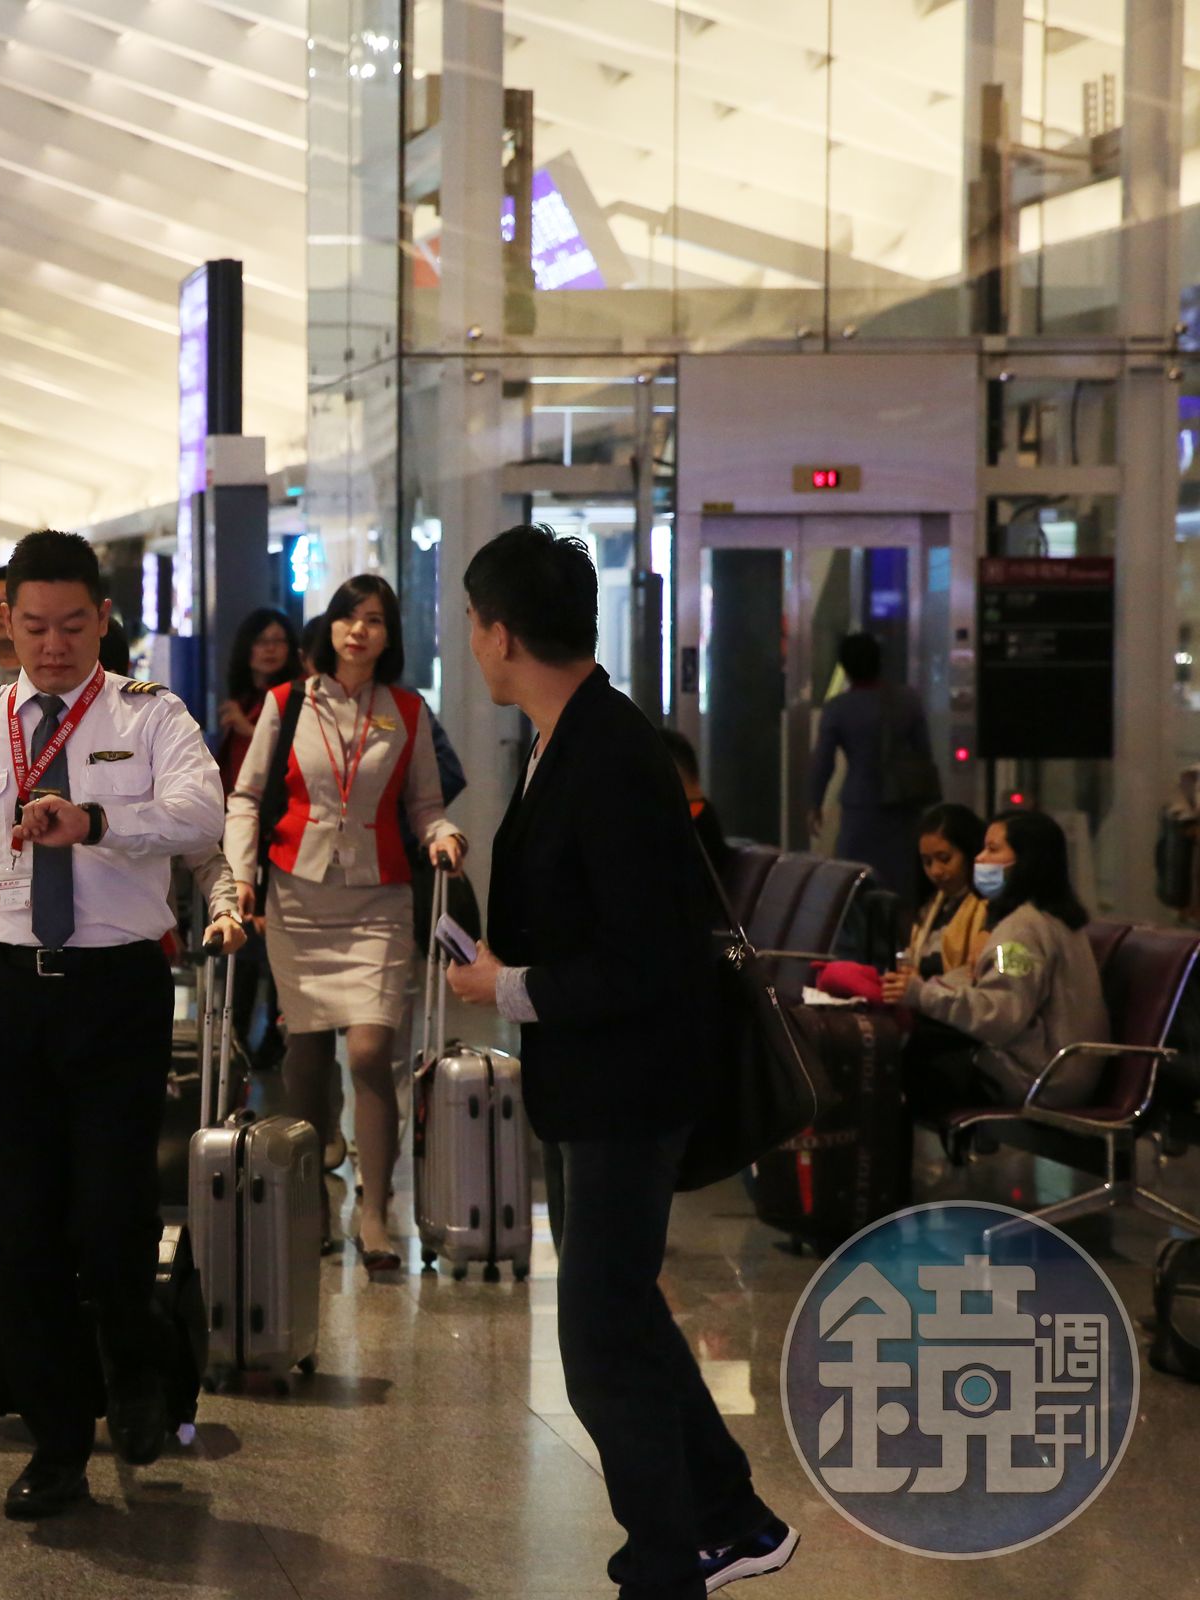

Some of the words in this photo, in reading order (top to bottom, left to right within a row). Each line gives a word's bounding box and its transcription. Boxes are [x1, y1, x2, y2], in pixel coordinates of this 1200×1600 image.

[10, 717, 20, 740] FLIGHT
[53, 721, 73, 748] REMOVE
[12, 740, 24, 764] BEFORE
[36, 745, 57, 770] BEFORE
[23, 768, 40, 791] FLIGHT
